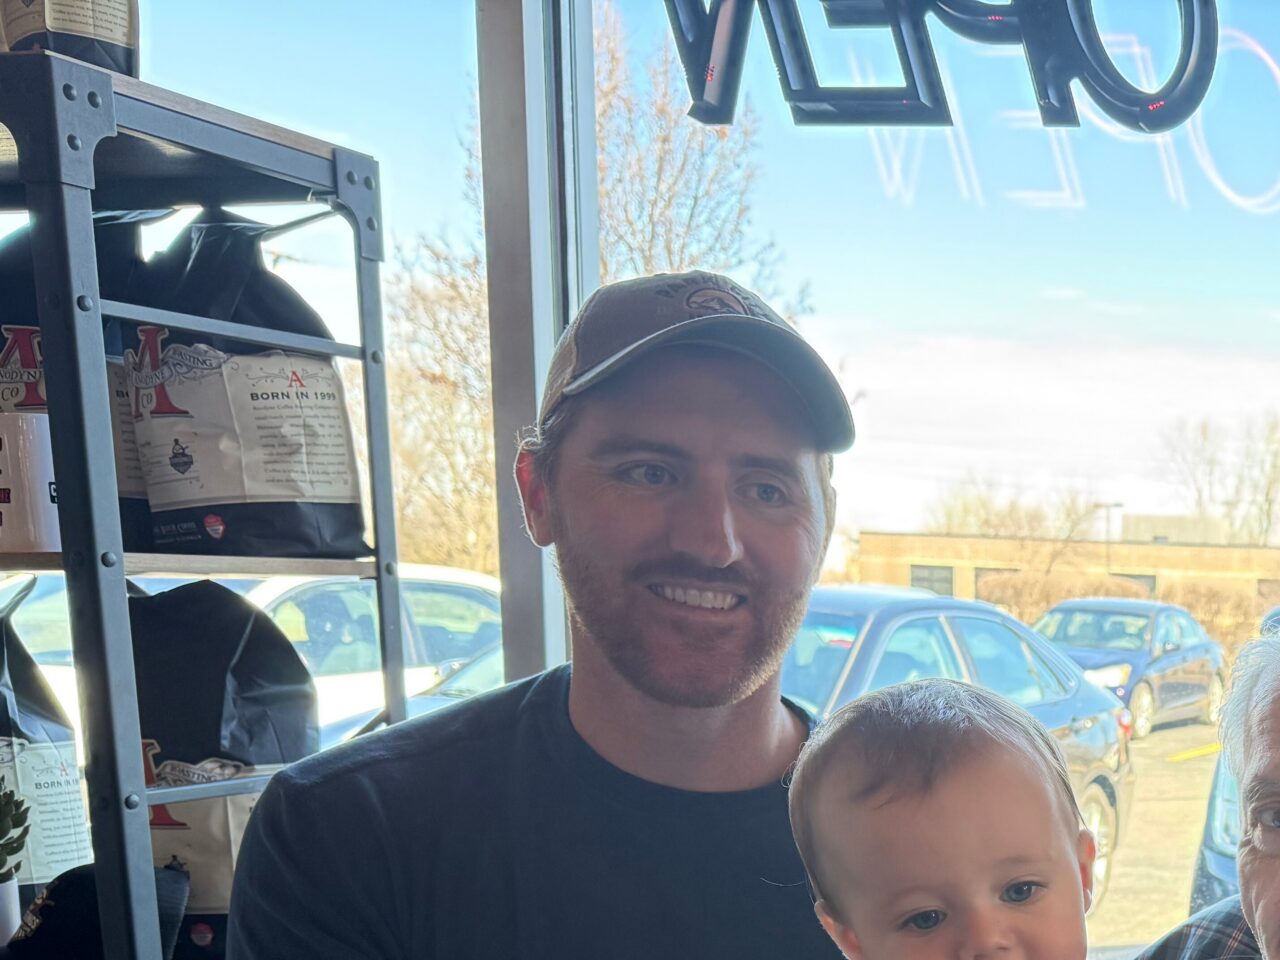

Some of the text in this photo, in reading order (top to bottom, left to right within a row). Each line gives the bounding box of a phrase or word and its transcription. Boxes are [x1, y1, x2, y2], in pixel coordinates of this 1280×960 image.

[288, 370, 306, 388] A
[2, 387, 19, 401] CO
[250, 391, 336, 401] BORN IN 1999
[34, 780, 62, 790] BORN
